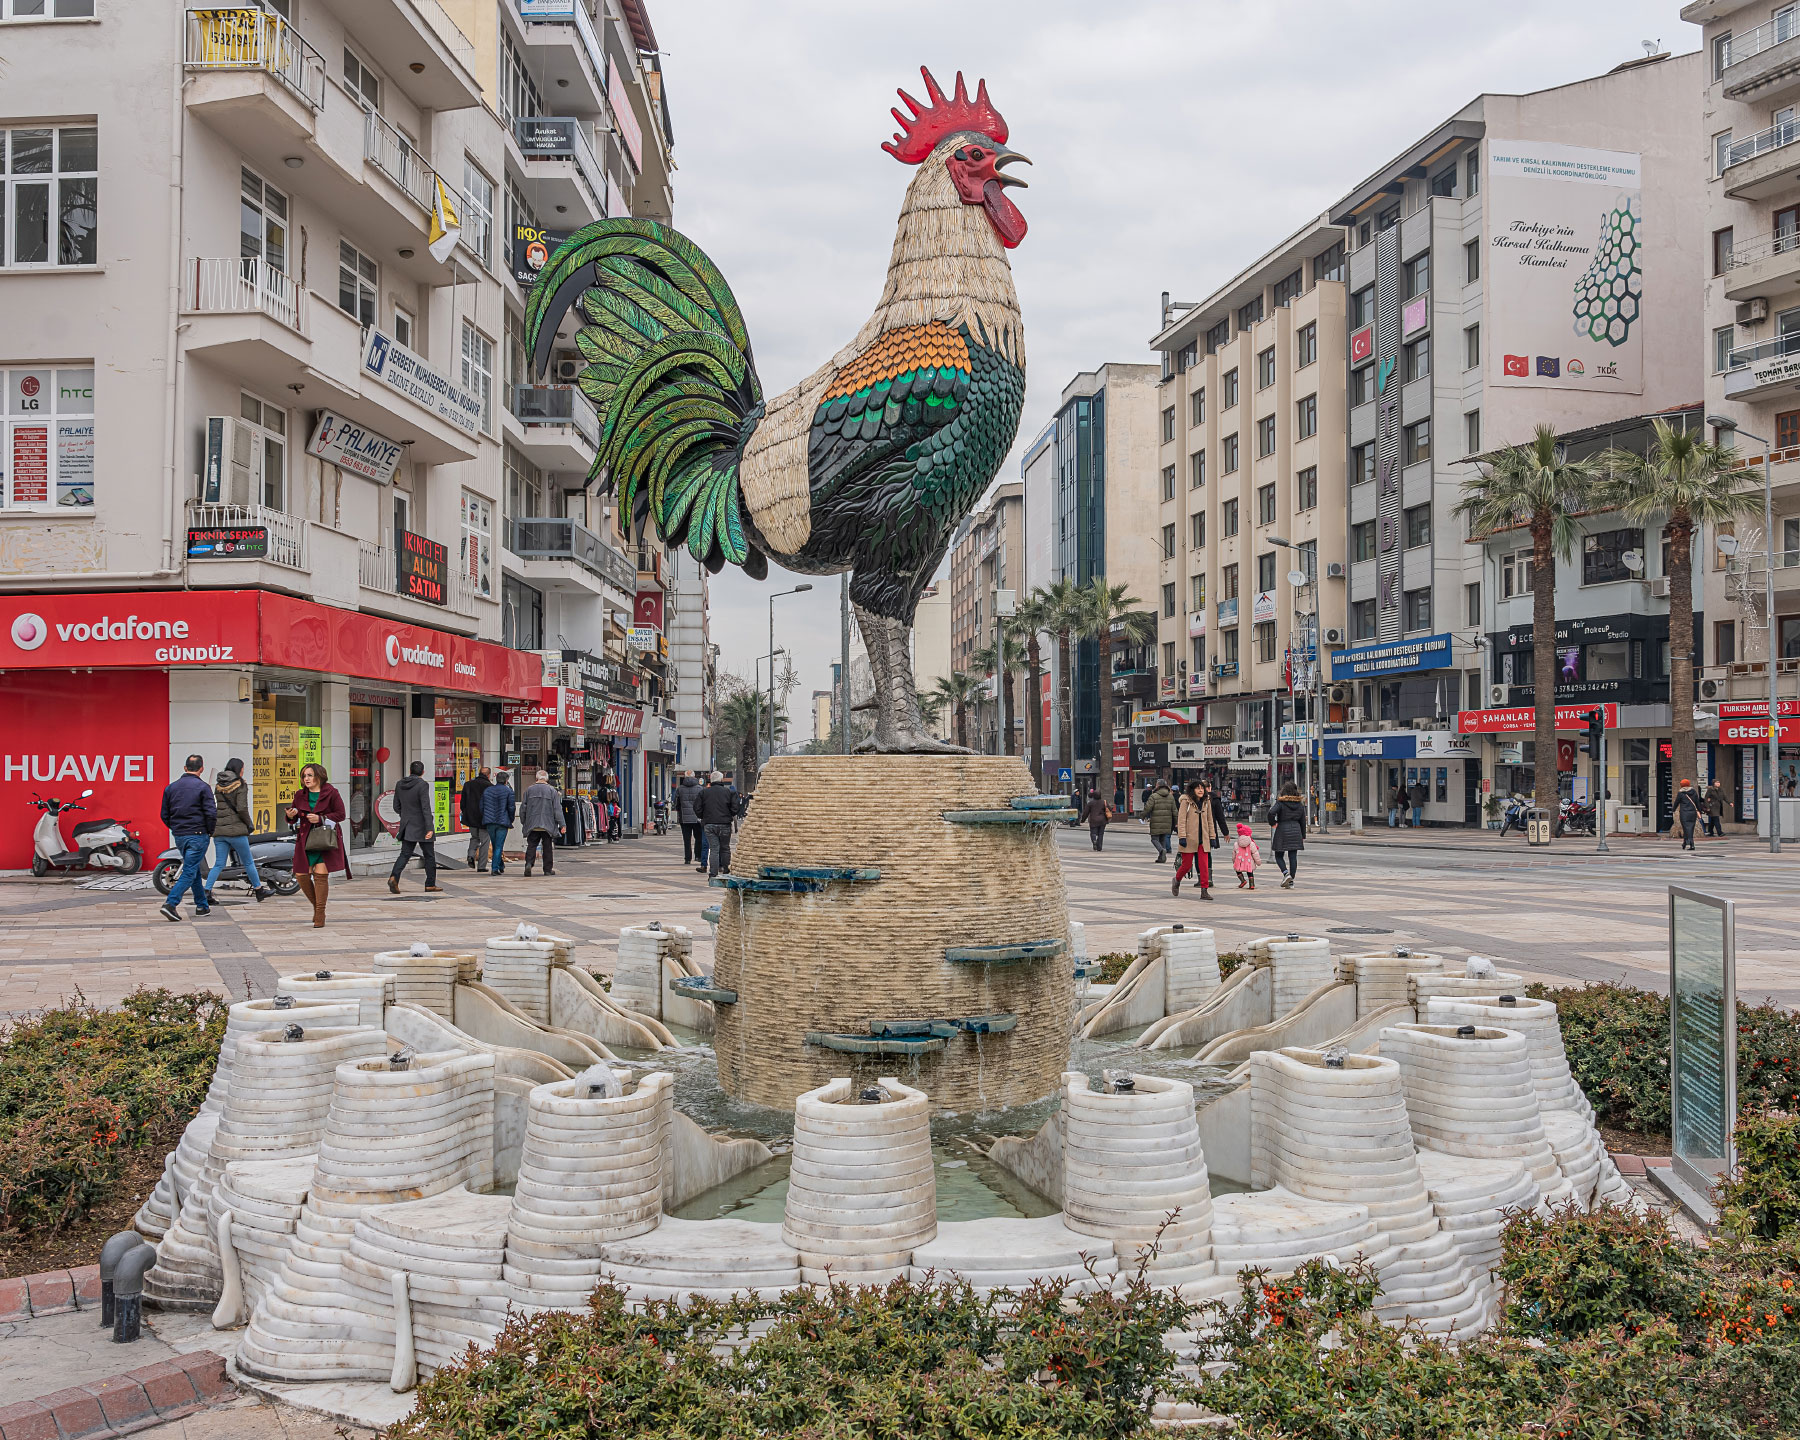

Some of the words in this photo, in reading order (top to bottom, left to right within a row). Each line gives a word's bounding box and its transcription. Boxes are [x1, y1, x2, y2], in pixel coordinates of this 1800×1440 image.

[1524, 166, 1546, 174] DENİZLİ
[1542, 160, 1576, 168] KALKINMAYI
[1576, 163, 1611, 172] DESTEKLEME
[1612, 167, 1636, 176] KURUMU
[1509, 220, 1575, 238] Türkiye'nin
[1492, 236, 1532, 250] Kırsal
[1534, 239, 1590, 254] Kalkınma
[1518, 254, 1568, 268] Hamlesi
[388, 347, 416, 374] SERBEST
[414, 363, 450, 396] MUHASEBECİ
[447, 386, 462, 404] MALİ
[1596, 366, 1618, 375] TKDK
[1754, 366, 1782, 380] TEOMAN
[388, 369, 411, 392] EMİNE
[21, 398, 40, 410] LG
[336, 423, 401, 466] PALMİYE
[1380, 400, 1396, 610] TKDK
[229, 528, 265, 540] SERVİS
[434, 544, 445, 564] EL
[414, 556, 438, 581] ALIM
[409, 575, 441, 601] SATIM
[56, 615, 189, 642] vodafone
[1572, 620, 1584, 628] Hair
[155, 644, 234, 662] GÜNDÜZ
[401, 644, 445, 668] vodafone
[1332, 655, 1346, 664] TARIM
[1351, 652, 1366, 662] KIRSAL
[1366, 648, 1393, 660] KALKINMAYI
[1393, 644, 1423, 656] DESTEKLEME
[1424, 640, 1446, 651] KURUMU
[454, 661, 476, 677] GÜNDÜZ
[1353, 661, 1370, 673] DENİZLİ
[1370, 660, 1375, 670] İL
[368, 694, 400, 706] VODAFONE
[566, 692, 584, 708] EFSANE
[504, 706, 556, 715] EFSANE
[568, 707, 581, 723] BÜFE
[512, 714, 547, 724] BÜFE
[1482, 714, 1529, 724] ŞAHANLAR
[1727, 725, 1788, 738] etstr
[262, 733, 273, 750] GB
[310, 740, 317, 750] GB
[1420, 740, 1432, 748] TKDK
[1204, 747, 1213, 756] EGE
[4, 754, 154, 782] HUAWEI
[260, 768, 270, 777] SMS
[256, 808, 270, 834] 49
